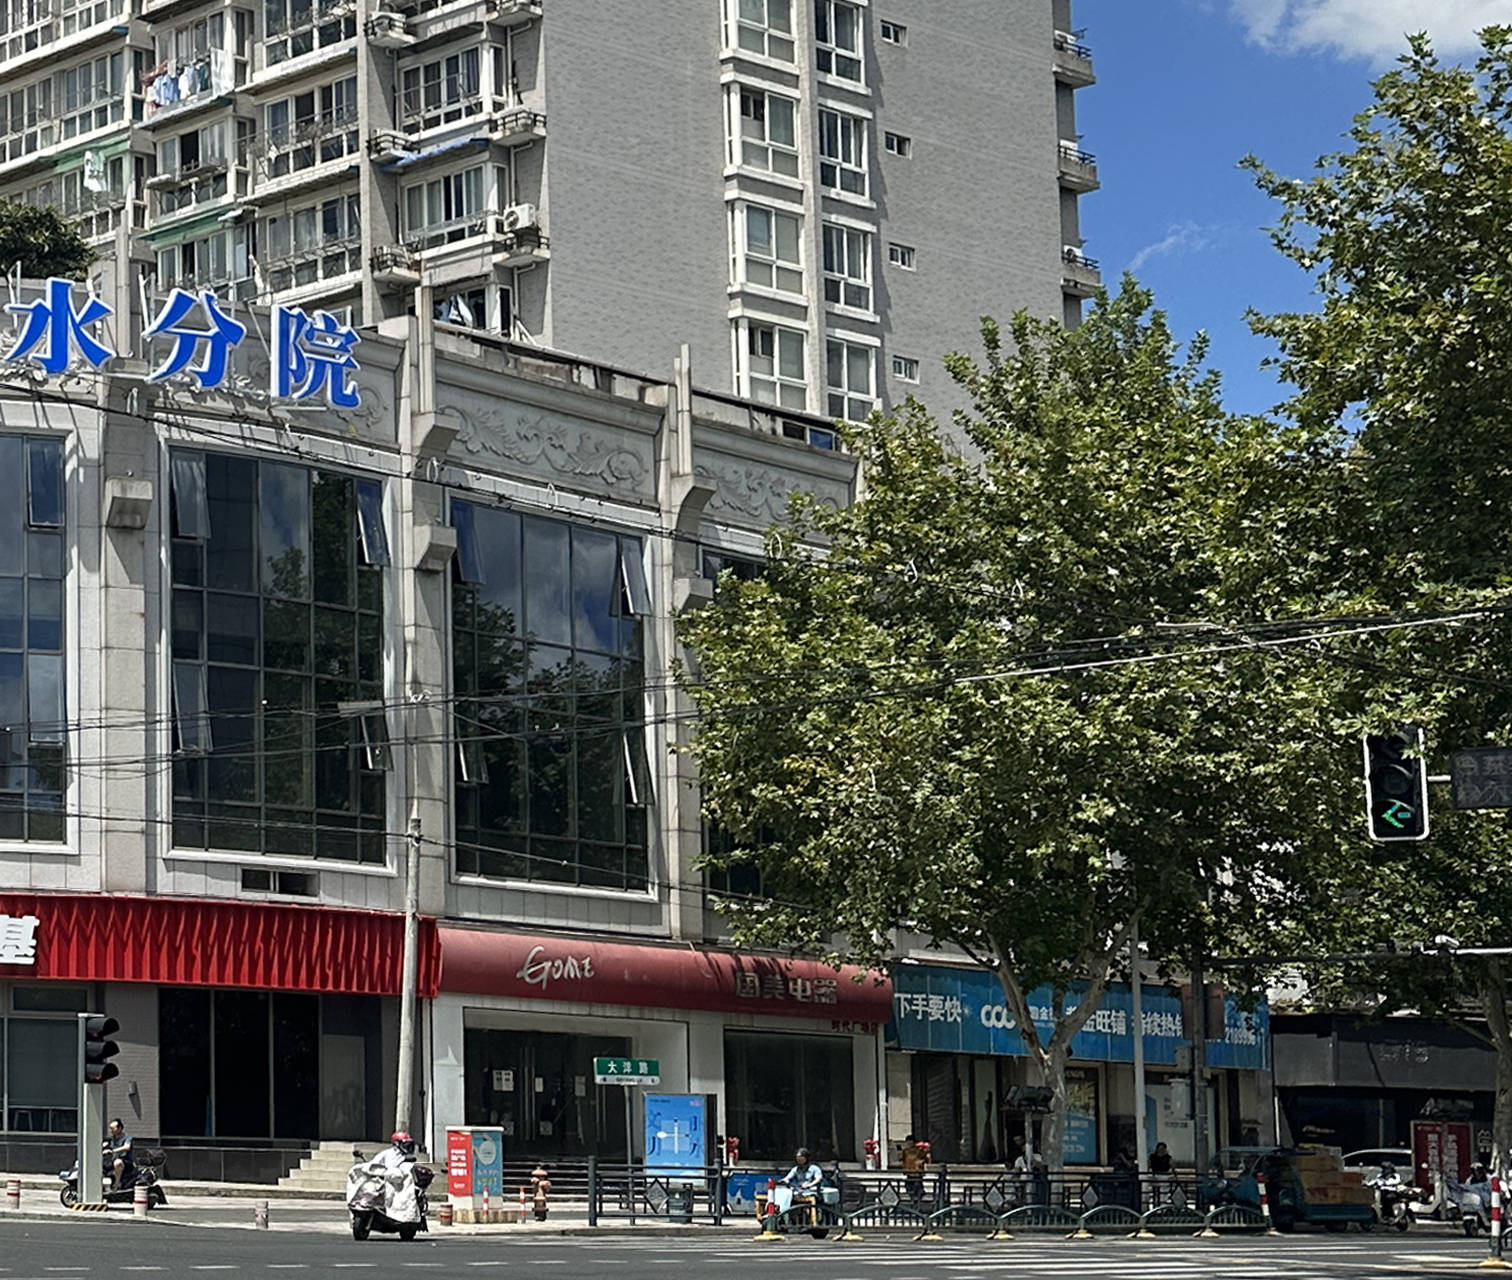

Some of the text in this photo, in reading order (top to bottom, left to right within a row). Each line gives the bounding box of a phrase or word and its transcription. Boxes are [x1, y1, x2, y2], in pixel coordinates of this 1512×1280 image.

[736, 971, 837, 1004] 国美电器
[894, 993, 962, 1023] 下手要快
